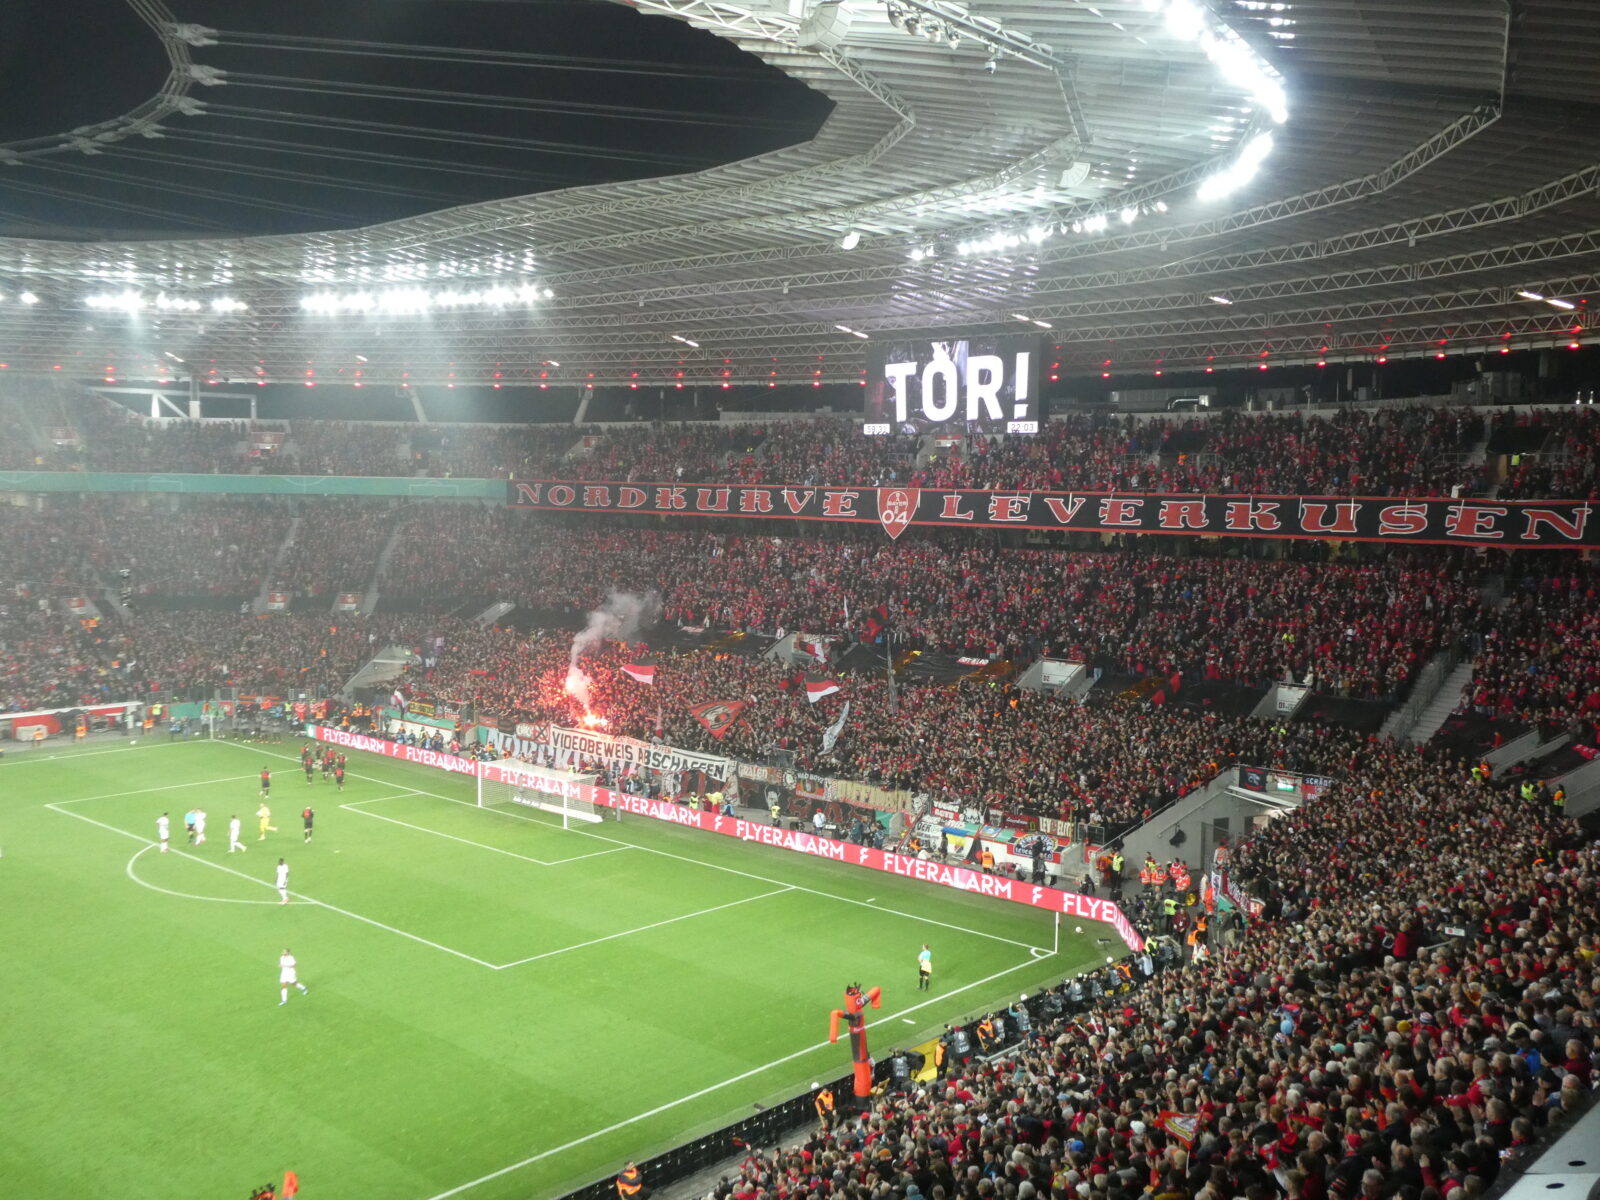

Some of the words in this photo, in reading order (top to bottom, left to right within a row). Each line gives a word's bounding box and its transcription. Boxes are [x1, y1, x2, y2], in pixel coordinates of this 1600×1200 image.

[885, 352, 1031, 422] TOR!
[516, 483, 858, 516] NORDKURVE
[882, 509, 908, 525] 04
[940, 495, 1592, 540] LEVERKUSEN
[551, 731, 634, 761] VIDEOBEWEIS
[323, 728, 386, 755] FLYERALARM
[406, 745, 475, 775] FLYERALARM
[736, 820, 845, 860] FLYERALARM
[884, 852, 1012, 899] FLYERALARM
